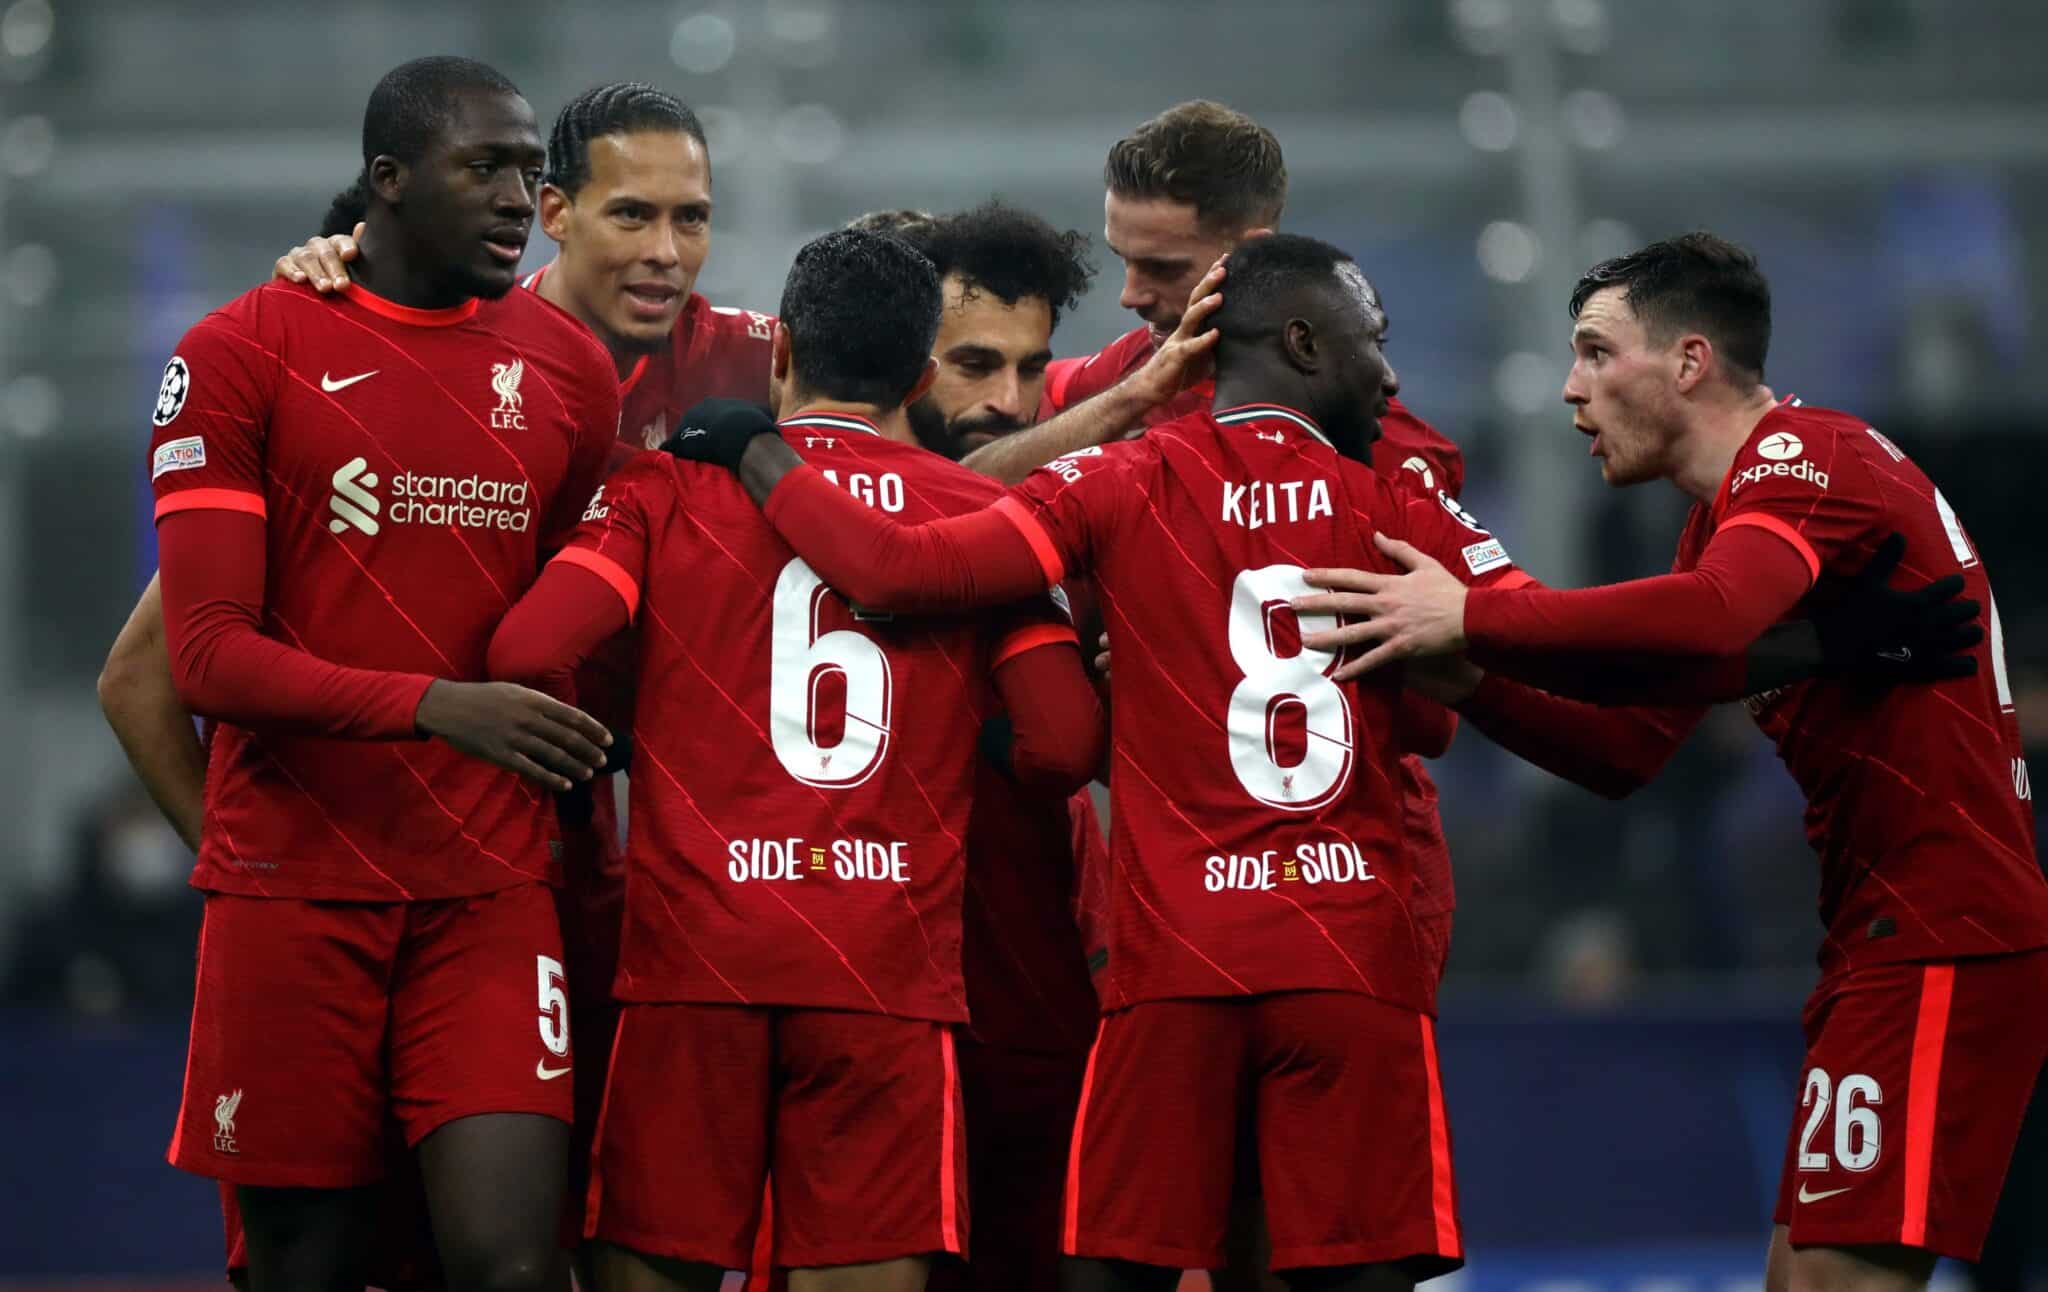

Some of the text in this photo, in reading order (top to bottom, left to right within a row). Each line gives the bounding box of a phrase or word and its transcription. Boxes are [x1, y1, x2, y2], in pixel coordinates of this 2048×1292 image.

[391, 470, 528, 506] standard
[1221, 479, 1334, 530] KEITA
[389, 498, 531, 533] chartered
[770, 556, 893, 789] 6
[1227, 564, 1354, 812] 8
[728, 838, 804, 883] SIDE
[831, 839, 911, 882] SIDE
[1204, 850, 1278, 892] SIDE
[1296, 842, 1376, 884] SIDE
[536, 954, 570, 1057] 5
[1799, 1067, 1883, 1172] 26
